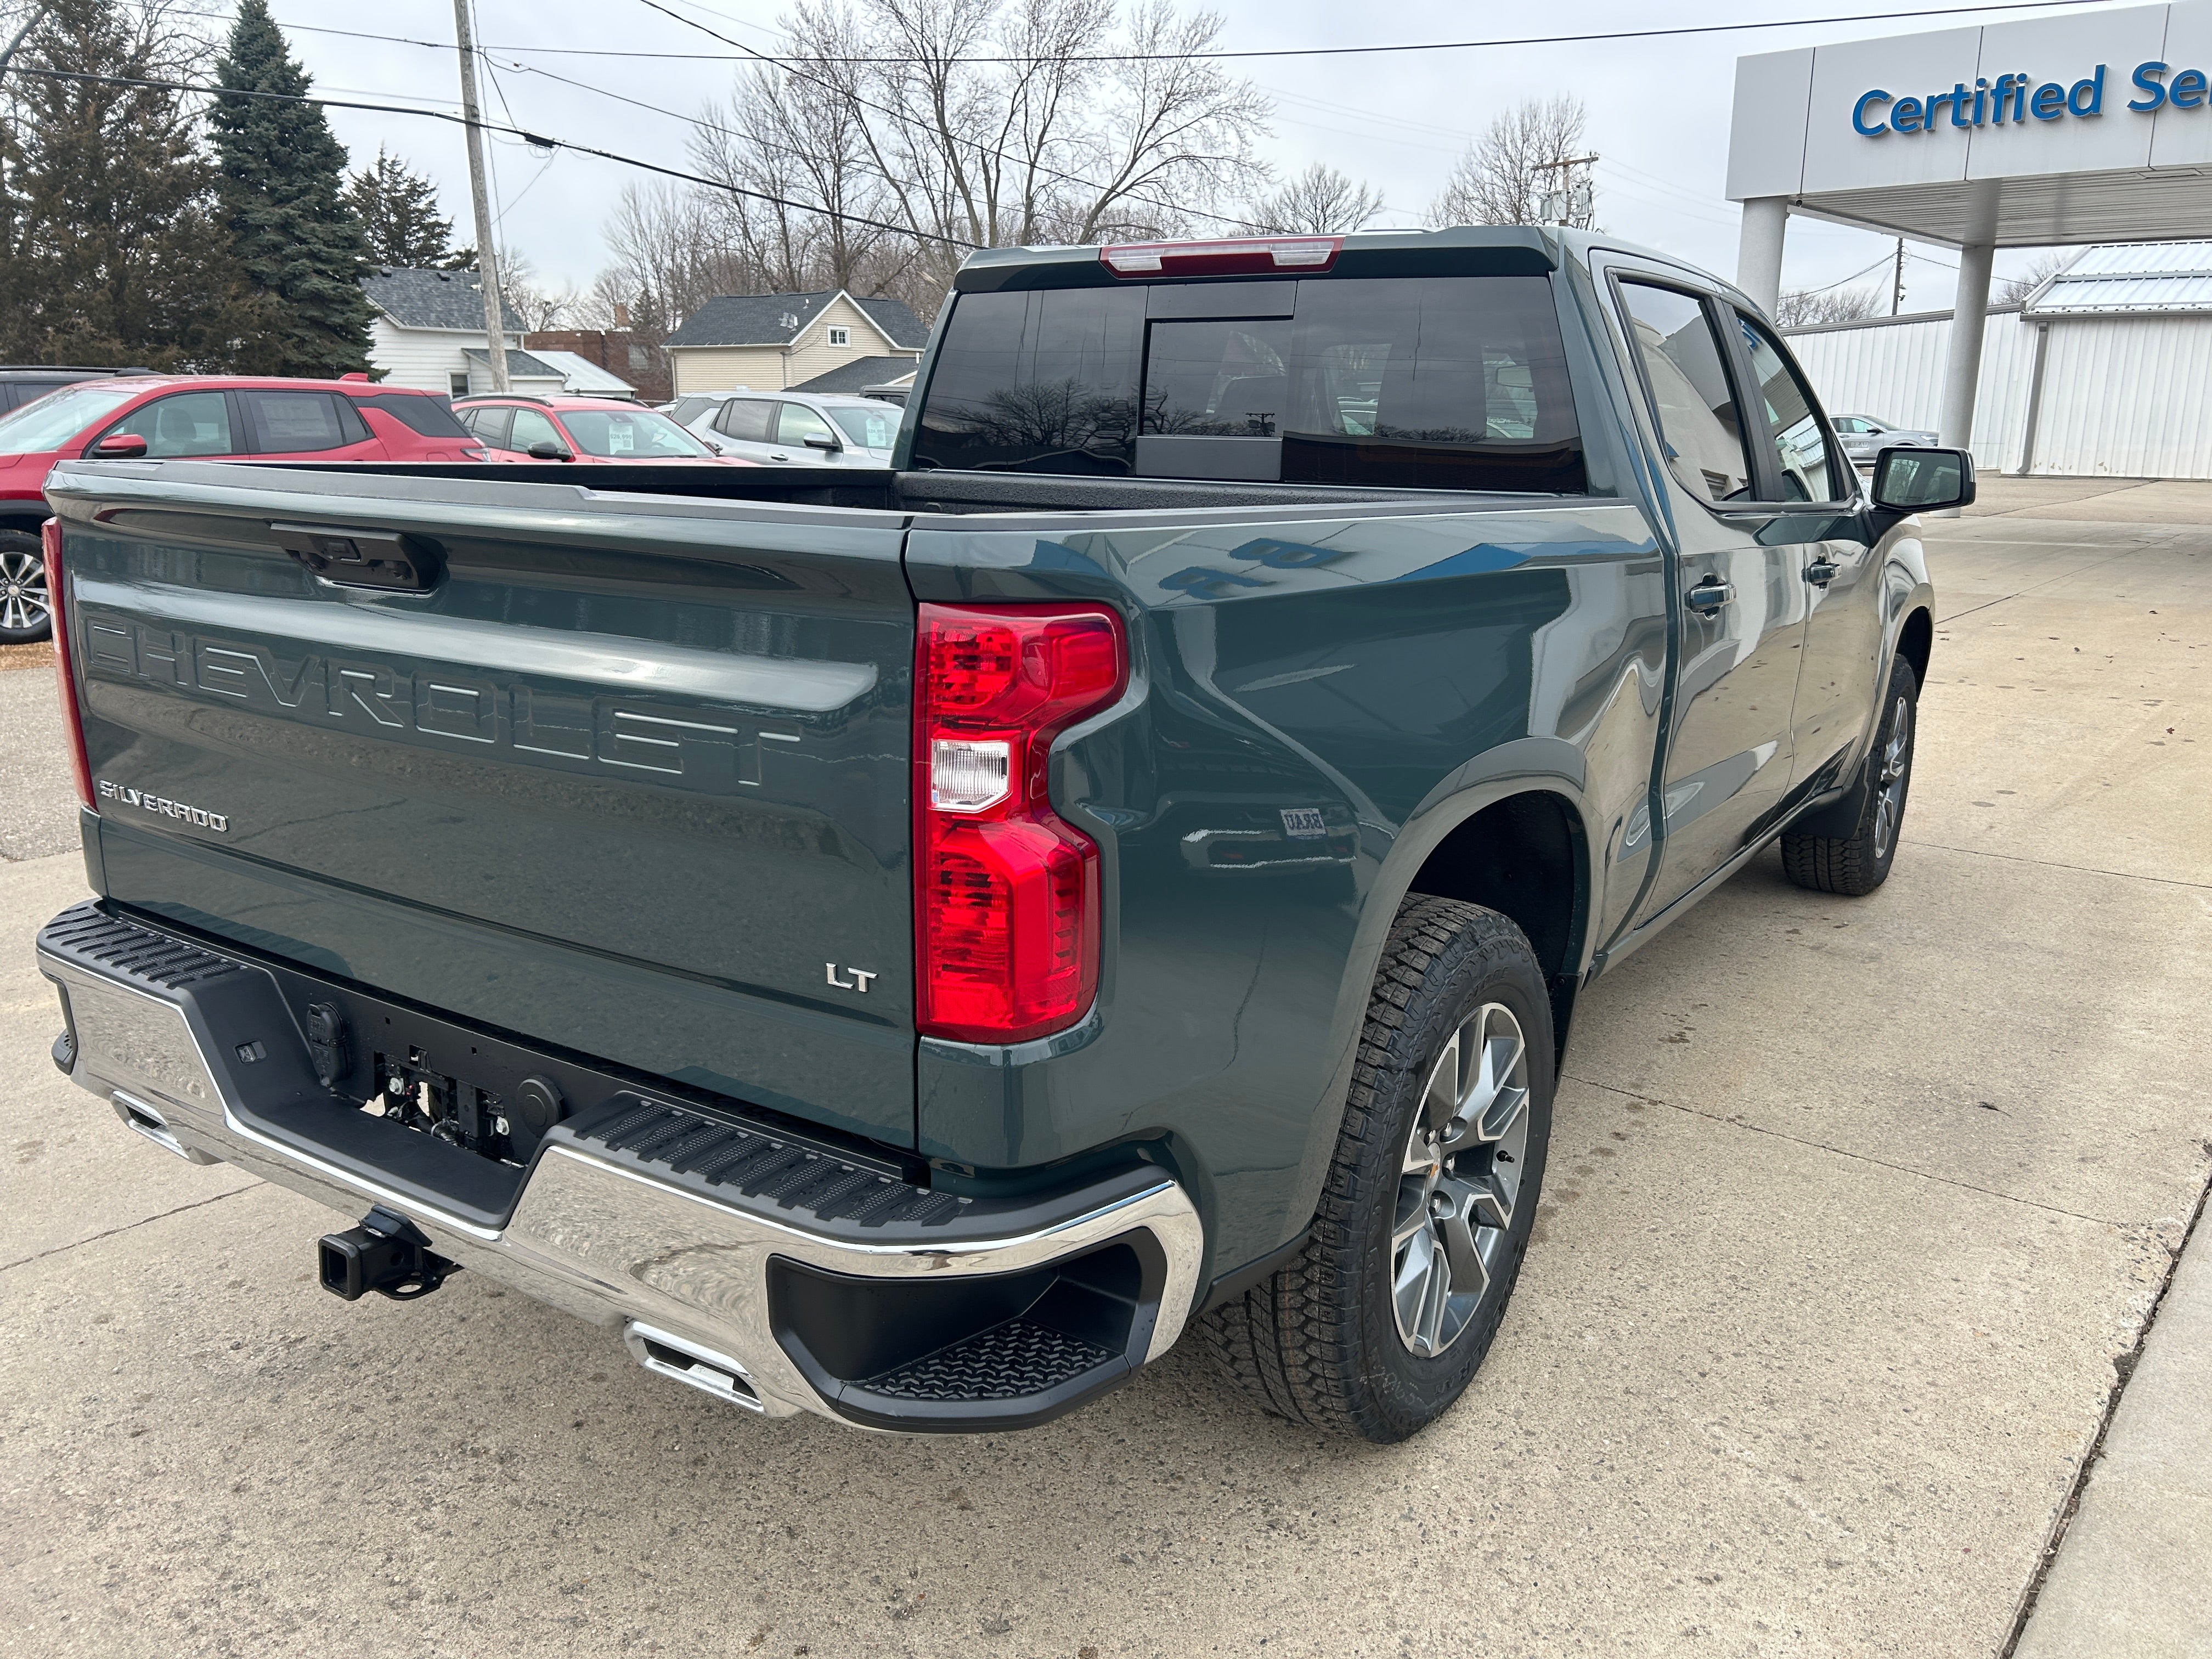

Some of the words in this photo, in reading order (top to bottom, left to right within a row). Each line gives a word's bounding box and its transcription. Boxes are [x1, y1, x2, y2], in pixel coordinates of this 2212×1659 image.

[1852, 64, 2107, 137] Certified
[2126, 61, 2212, 111] Se
[86, 616, 802, 787] CHEVROLET
[99, 780, 229, 832] SILVERADO
[826, 962, 878, 993] LT
